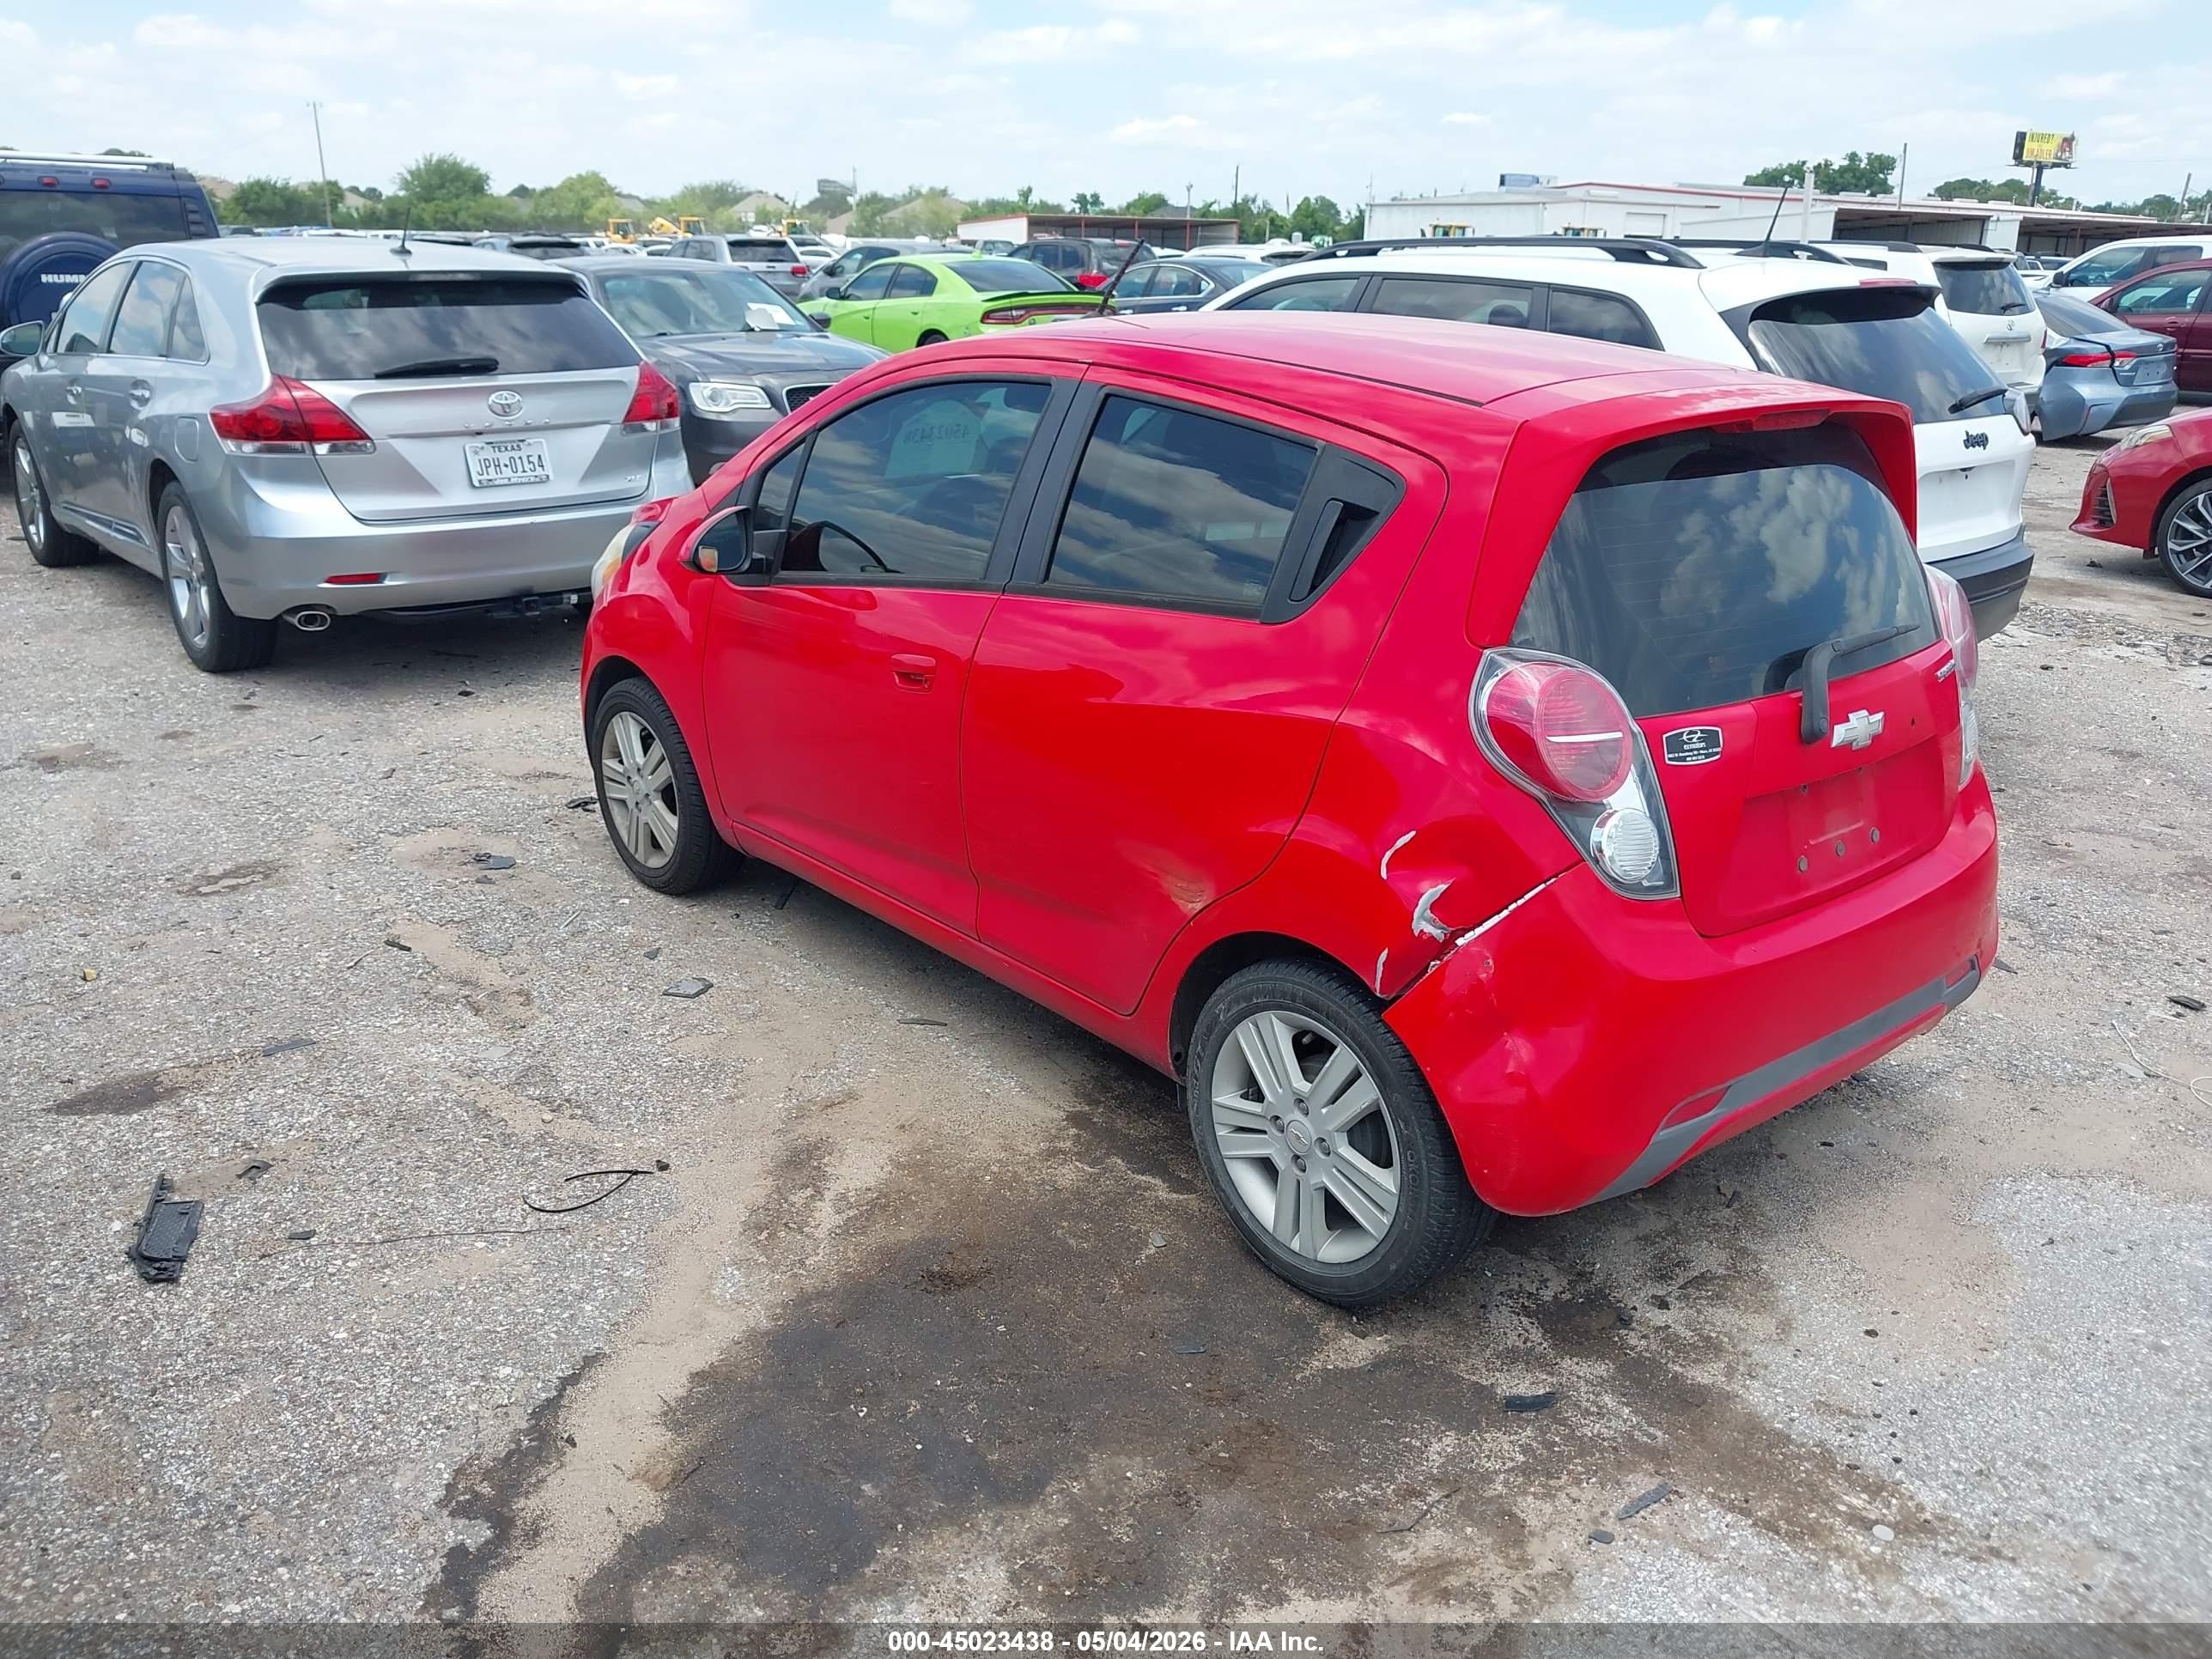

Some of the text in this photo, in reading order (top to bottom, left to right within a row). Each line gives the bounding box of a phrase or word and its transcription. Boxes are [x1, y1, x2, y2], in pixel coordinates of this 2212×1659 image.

[40, 273, 88, 283] HUM
[1963, 429, 1989, 451] Jeep
[490, 444, 522, 453] TEXAS
